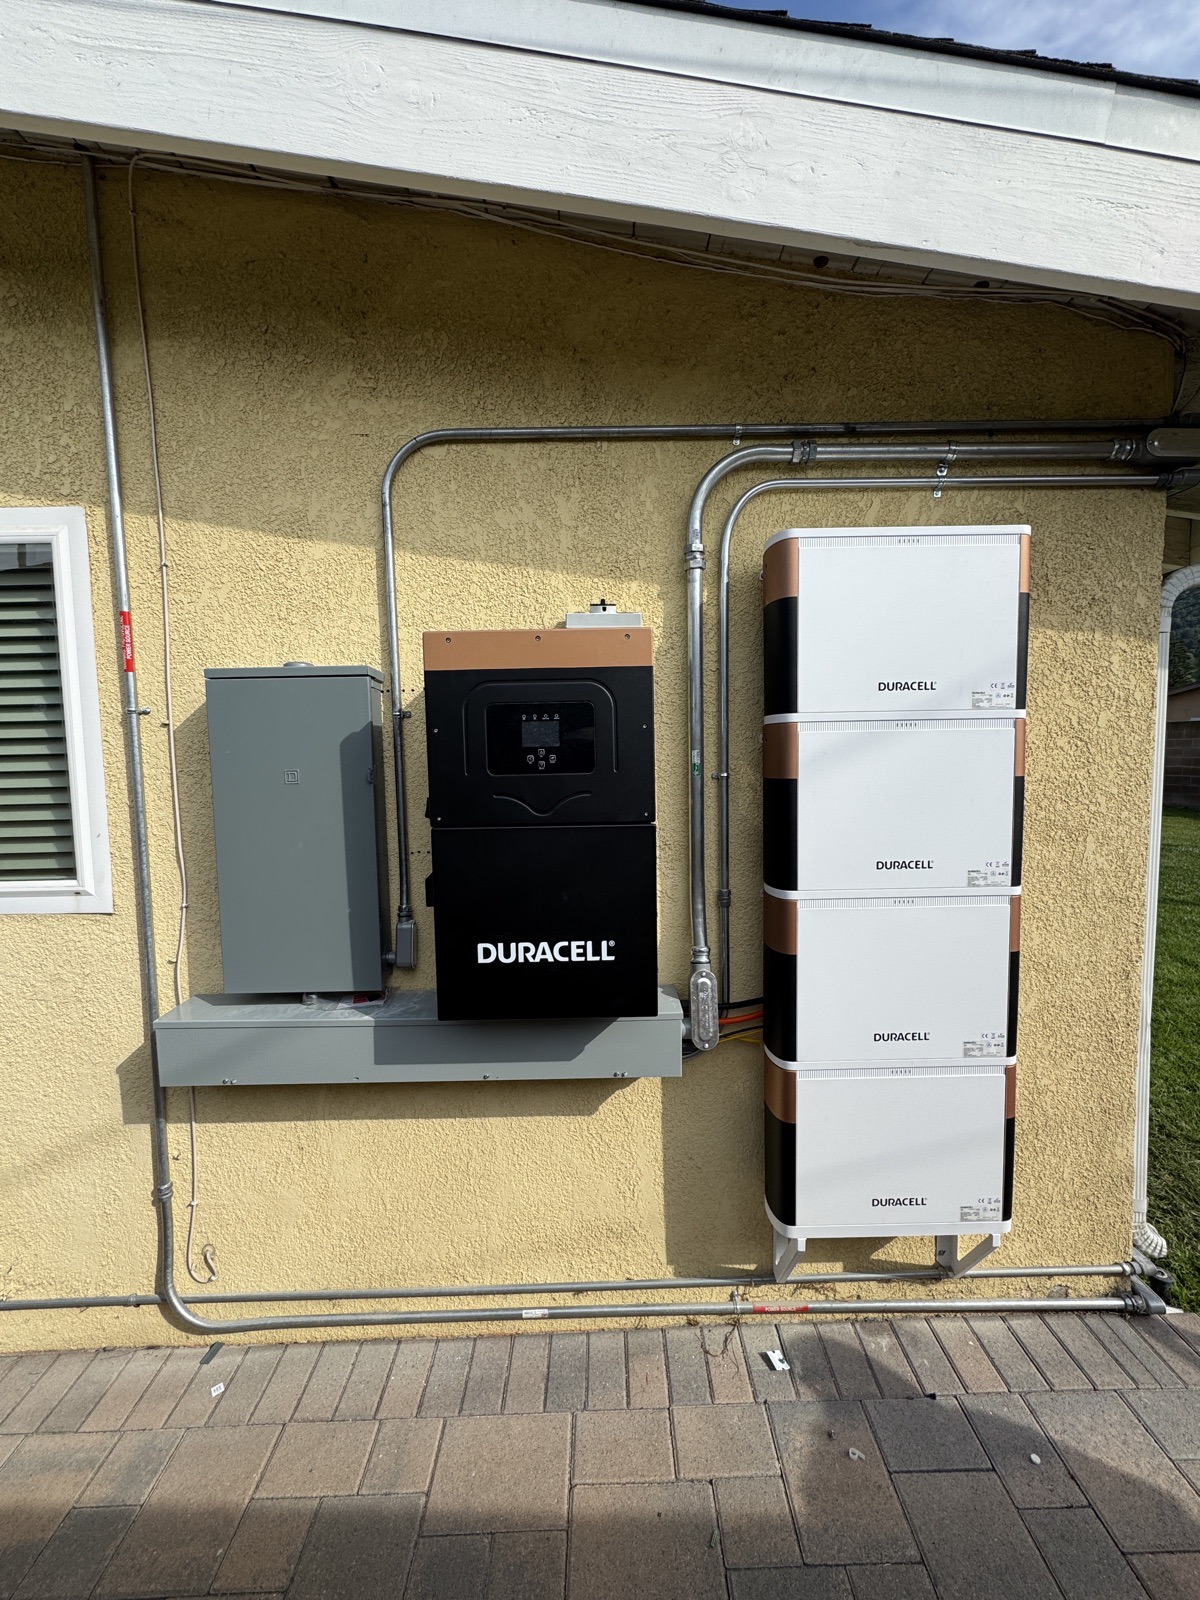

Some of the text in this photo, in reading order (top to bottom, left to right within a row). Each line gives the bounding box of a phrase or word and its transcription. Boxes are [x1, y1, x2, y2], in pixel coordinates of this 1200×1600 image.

[878, 681, 937, 692] DURACELL
[876, 860, 934, 870] DURACELL
[873, 1032, 930, 1042] DURACELL
[871, 1198, 928, 1207] DURACELL
